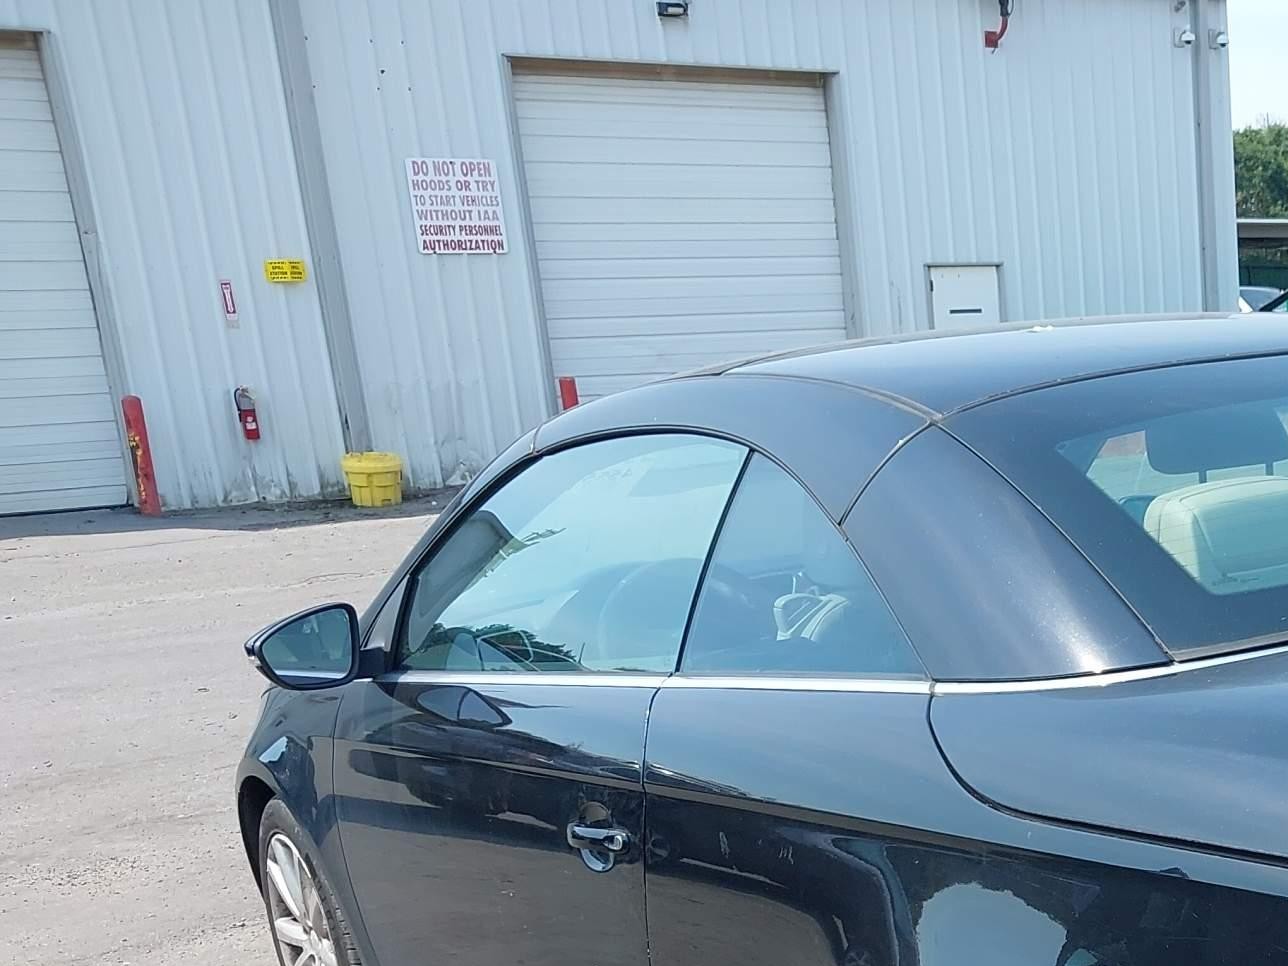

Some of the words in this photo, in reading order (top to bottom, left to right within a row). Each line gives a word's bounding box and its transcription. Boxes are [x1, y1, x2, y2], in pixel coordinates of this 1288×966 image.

[411, 160, 429, 177] DO
[432, 160, 456, 177] NOT
[460, 161, 491, 177] OPEN
[411, 179, 452, 192] HOODS
[455, 179, 472, 192] OR
[474, 180, 496, 193] TRY
[413, 194, 426, 207] TO
[428, 194, 456, 207] START
[459, 195, 499, 207] VEHICLES
[416, 209, 473, 221] WITHOUT
[477, 209, 499, 221] IAA
[420, 224, 456, 236] SECURITY
[458, 224, 503, 236] PERSONNEL
[422, 239, 504, 251] AUTHORIZATION
